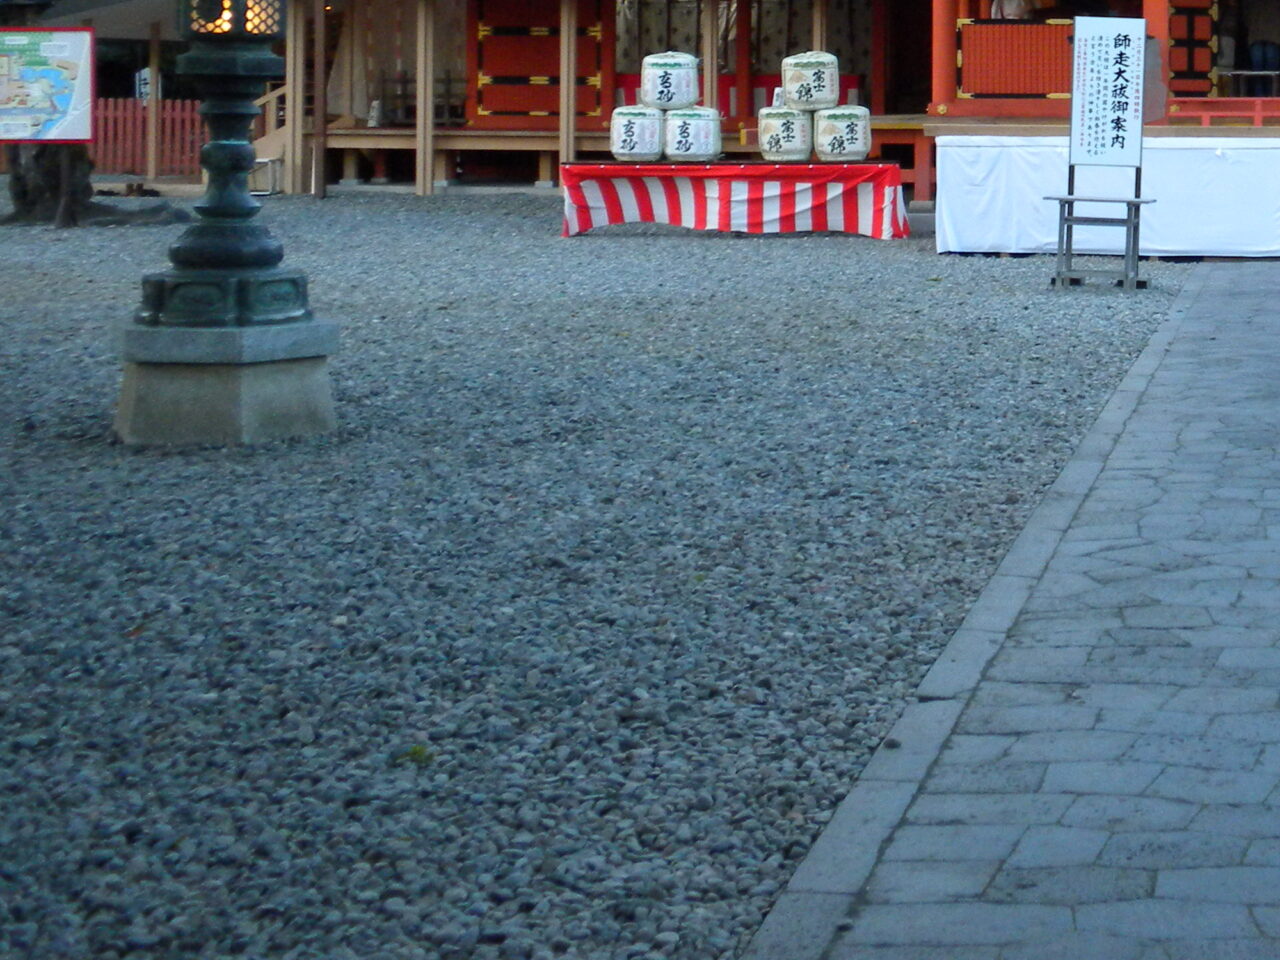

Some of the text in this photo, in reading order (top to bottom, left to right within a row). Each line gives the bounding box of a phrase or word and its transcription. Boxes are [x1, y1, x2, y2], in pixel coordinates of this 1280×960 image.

[1110, 32, 1131, 149] 師走大祓御案内
